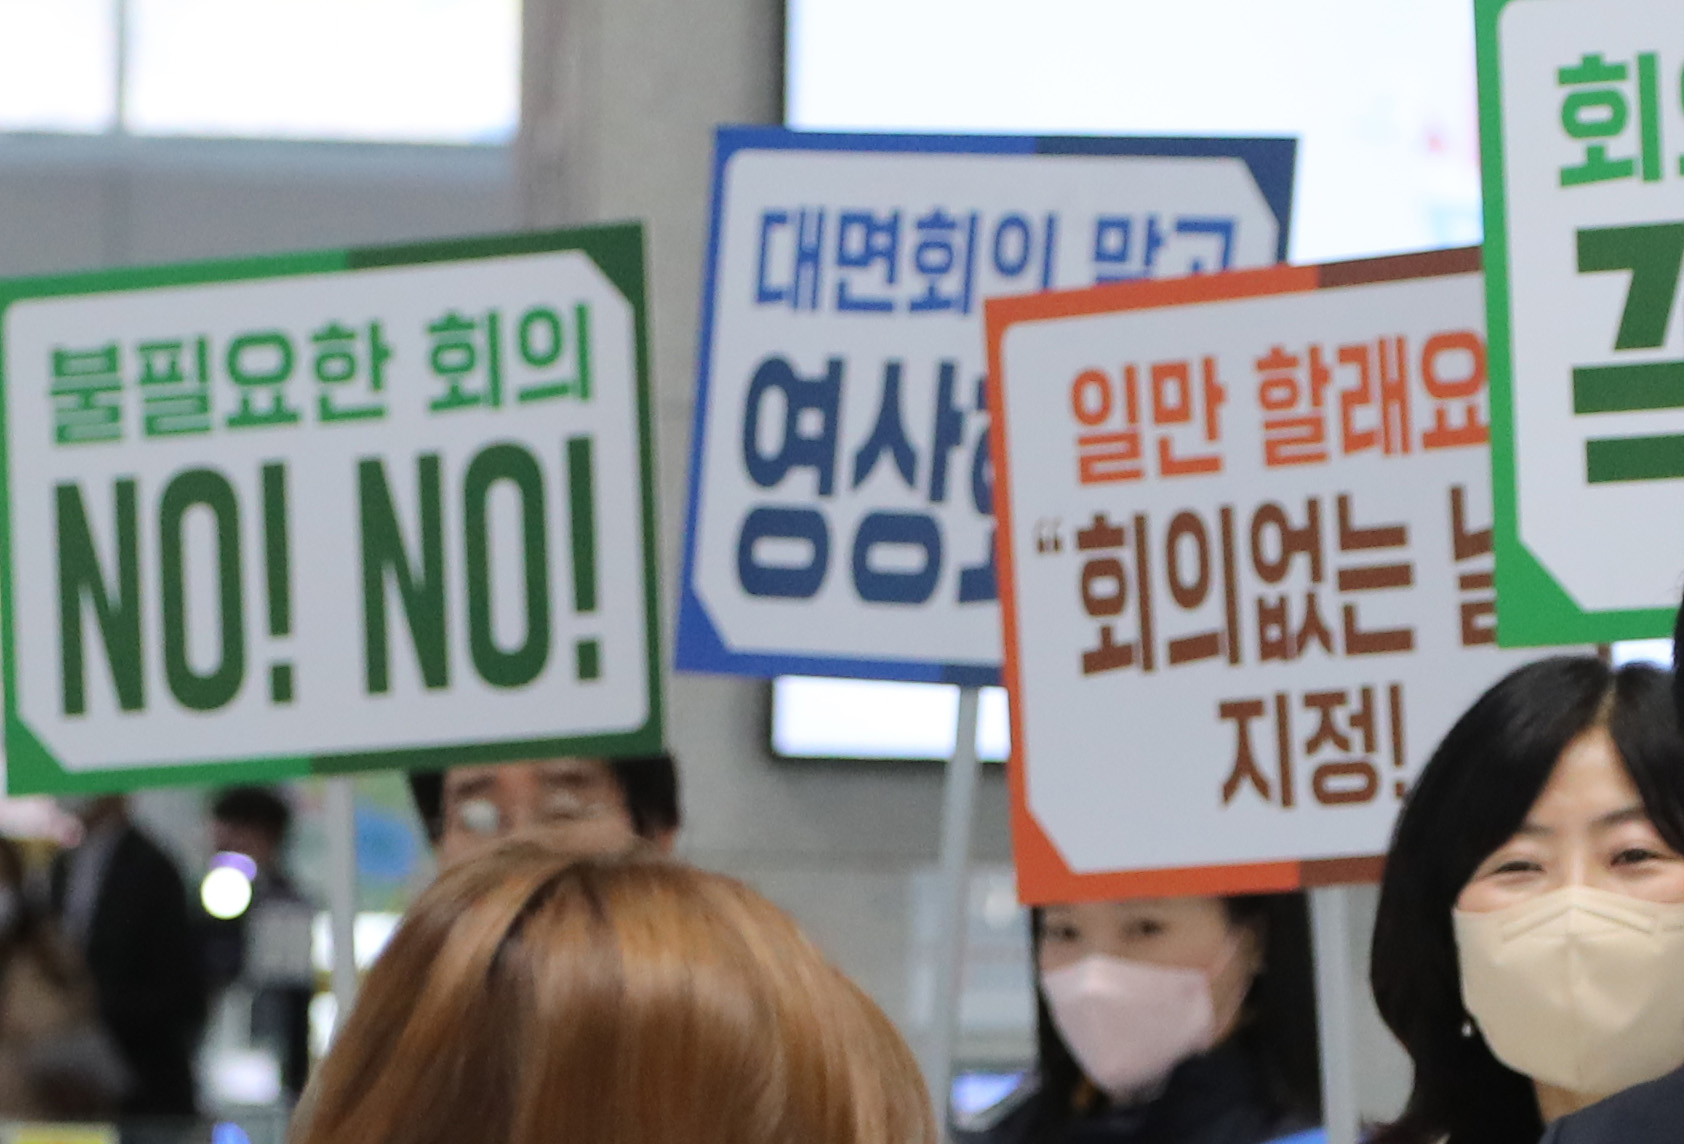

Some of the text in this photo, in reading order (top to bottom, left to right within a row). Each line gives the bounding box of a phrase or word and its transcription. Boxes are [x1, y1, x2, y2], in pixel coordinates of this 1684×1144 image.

[48, 301, 593, 447] 불필요한 회의
[1069, 329, 1492, 487] 일만 할래요
[735, 352, 1000, 606] 영상
[53, 436, 602, 719] NO! NO!
[1218, 684, 1407, 811] 지정!
